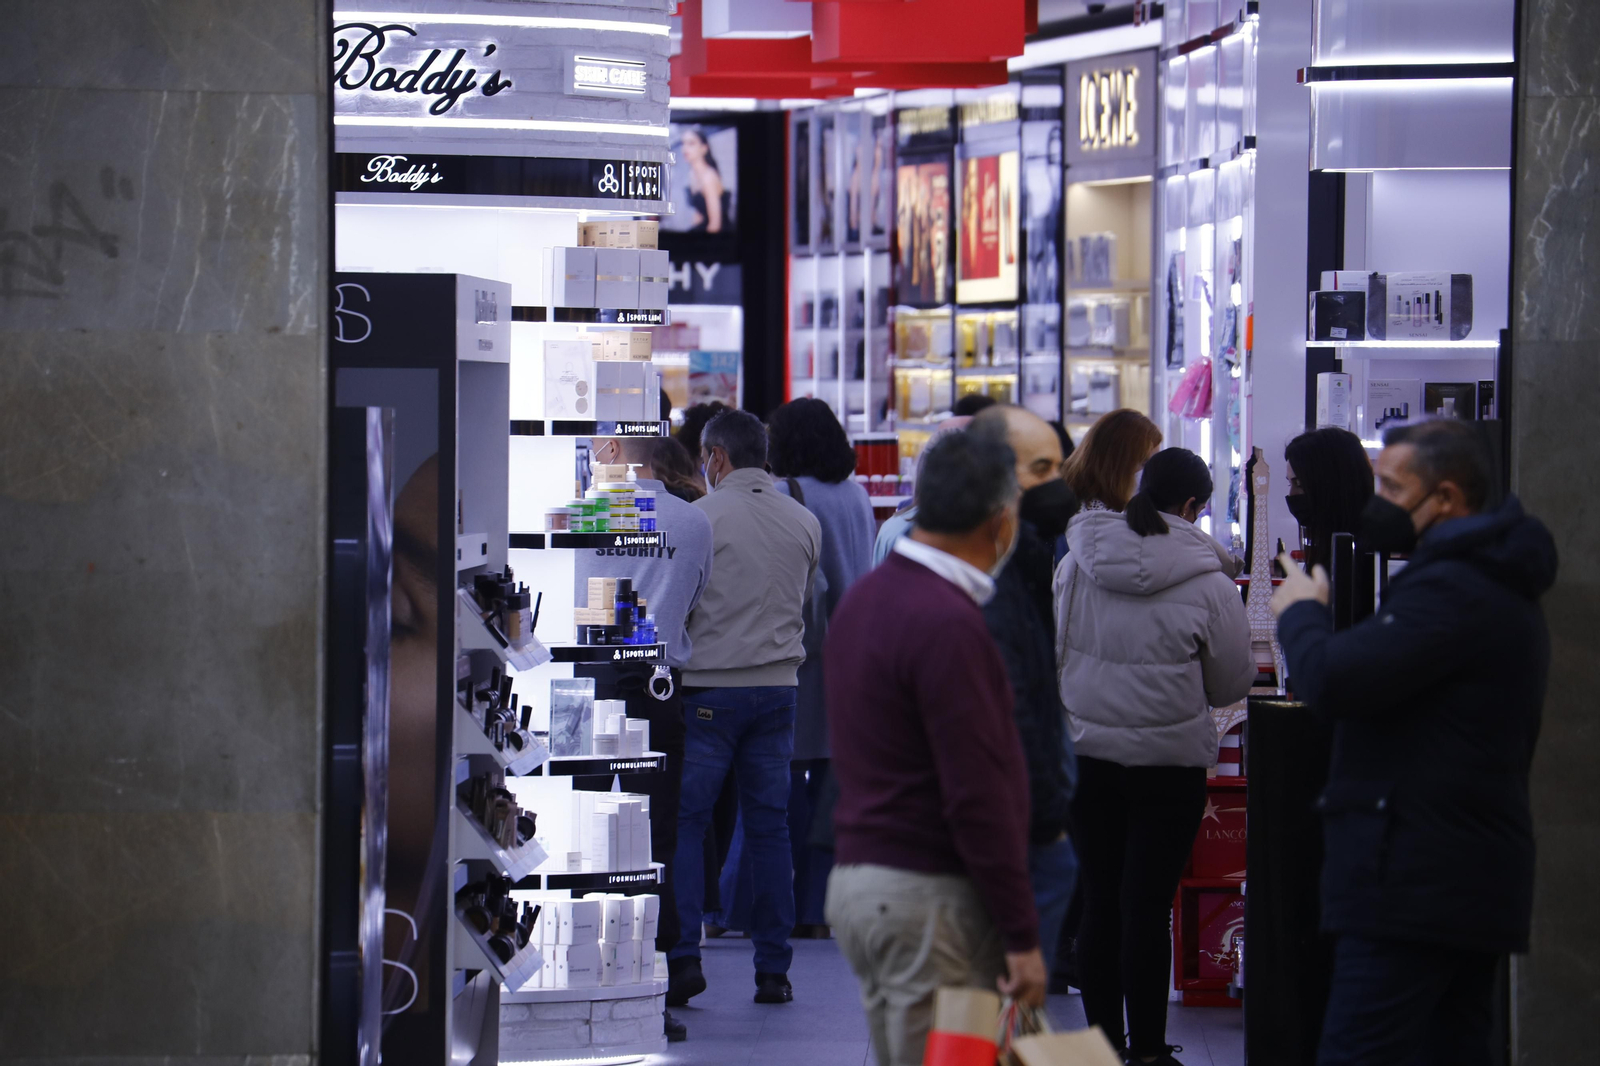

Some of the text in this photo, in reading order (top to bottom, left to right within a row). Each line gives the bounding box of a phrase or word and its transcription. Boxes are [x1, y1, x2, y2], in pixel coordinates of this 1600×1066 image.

[333, 22, 512, 116] Boddy's
[574, 65, 647, 86] SKIN CARE
[360, 155, 444, 191] Boddy's
[628, 165, 657, 179] SPOTS
[628, 181, 657, 196] LAB+
[629, 314, 647, 322] SPOTS
[628, 425, 646, 433] SPOTS
[627, 537, 645, 545] SPOTS
[595, 547, 677, 559] SECURITY
[626, 650, 644, 658] SPOTS
